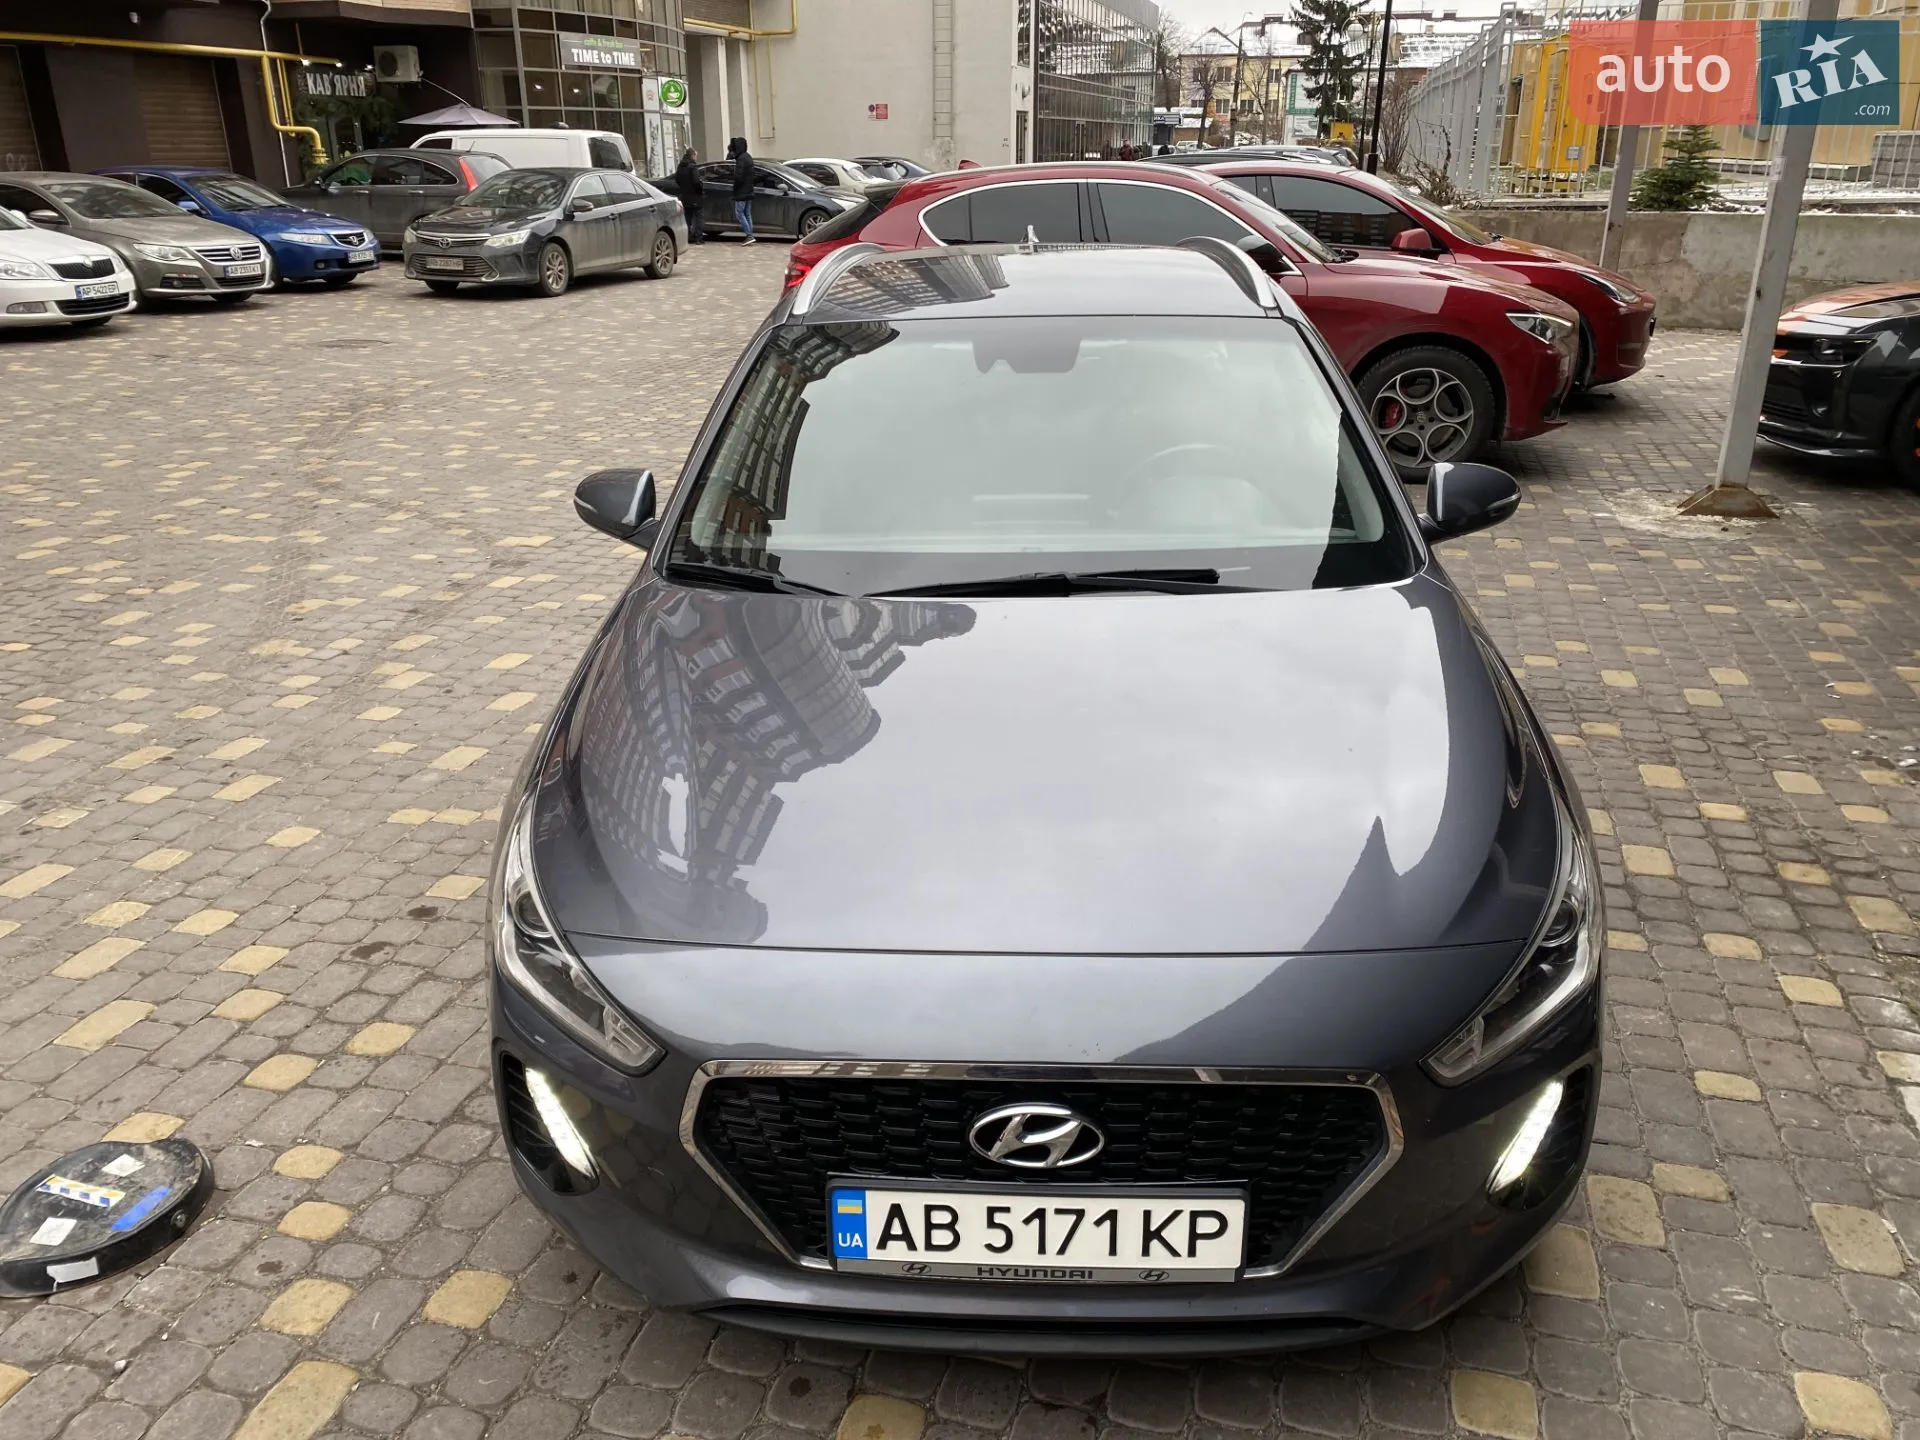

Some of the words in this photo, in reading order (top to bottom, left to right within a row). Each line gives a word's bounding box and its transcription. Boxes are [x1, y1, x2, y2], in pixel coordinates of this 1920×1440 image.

[571, 48, 600, 64] TIME
[600, 51, 612, 65] to
[612, 51, 635, 66] TIME
[876, 1203, 961, 1252] AB
[984, 1206, 1118, 1257] 5171
[1141, 1209, 1229, 1259] KP
[838, 1232, 863, 1248] UA
[977, 1266, 1093, 1280] HYUNDAI
